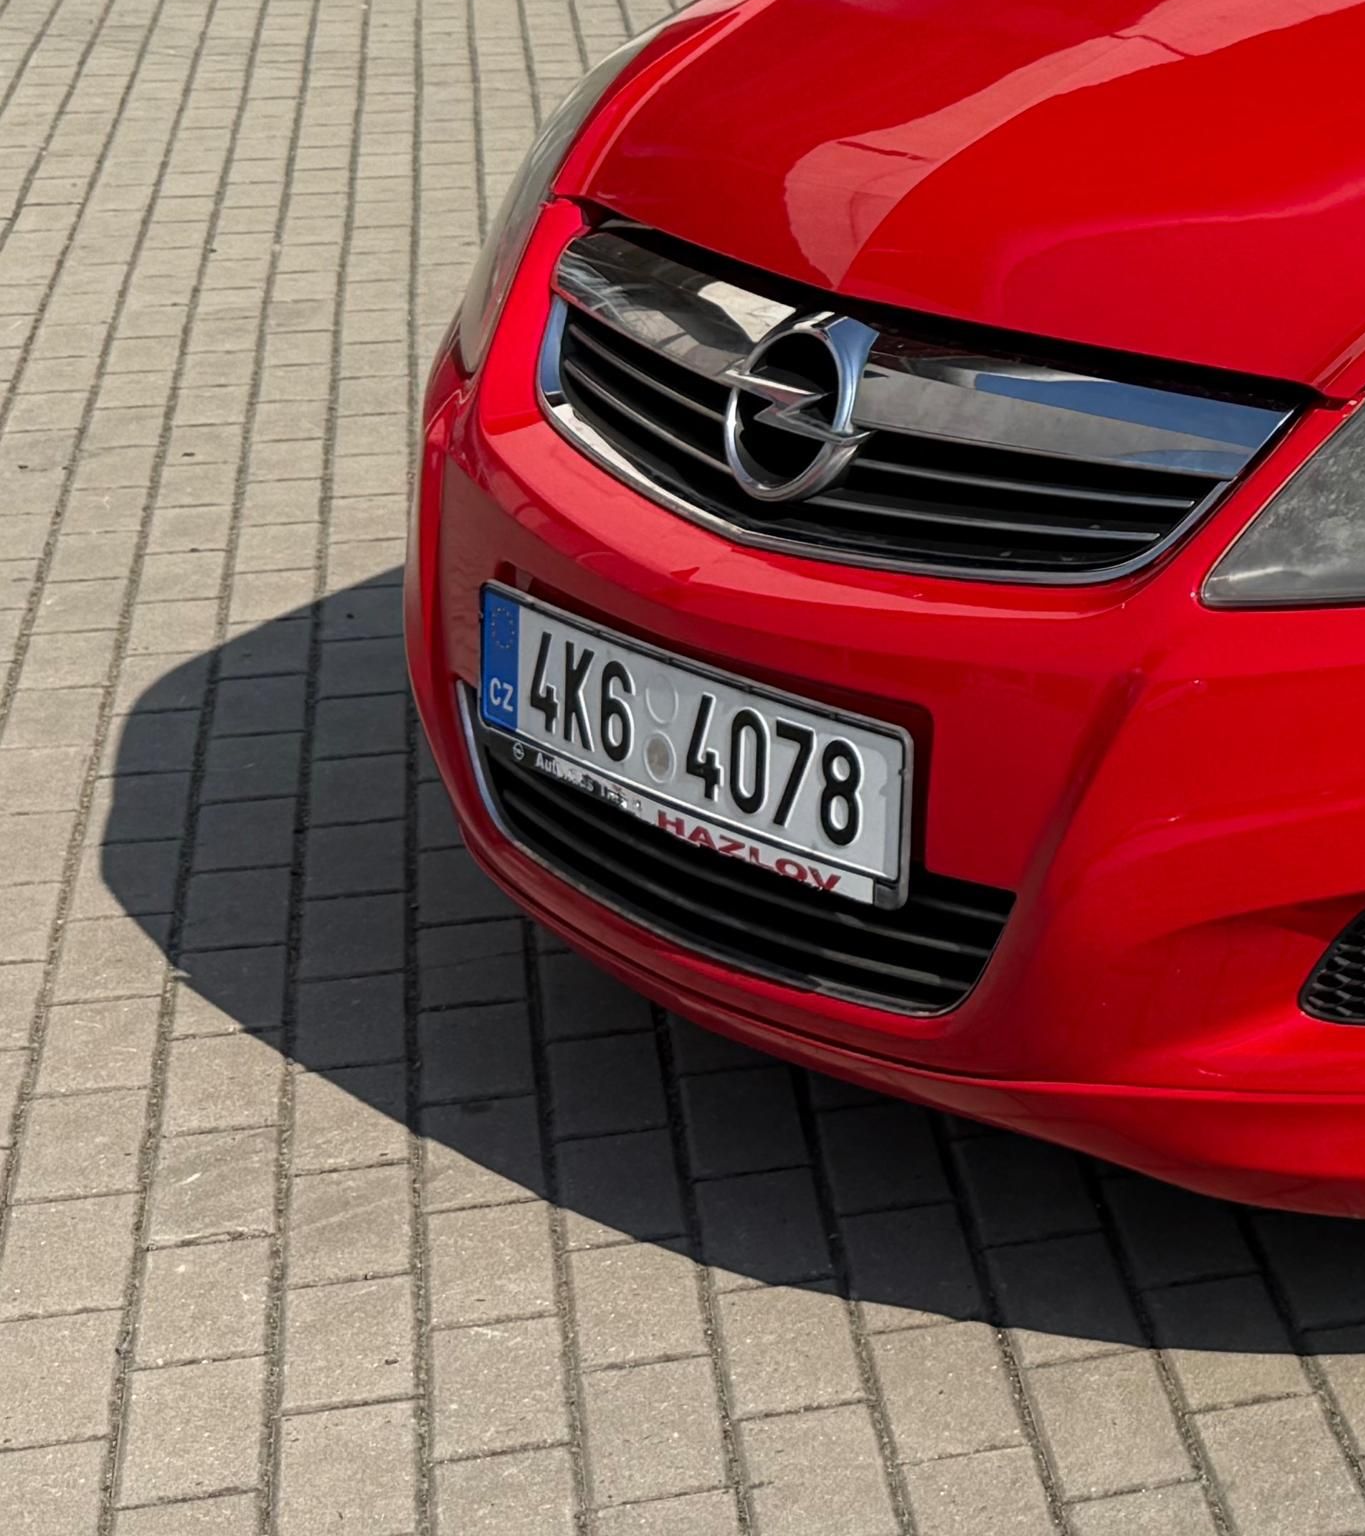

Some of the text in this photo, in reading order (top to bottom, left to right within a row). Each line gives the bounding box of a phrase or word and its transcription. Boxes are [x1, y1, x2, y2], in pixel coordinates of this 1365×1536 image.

[489, 677, 514, 713] CZ
[530, 630, 637, 762] 4K6
[686, 692, 864, 847] 4078
[657, 809, 842, 892] HAZLOV
